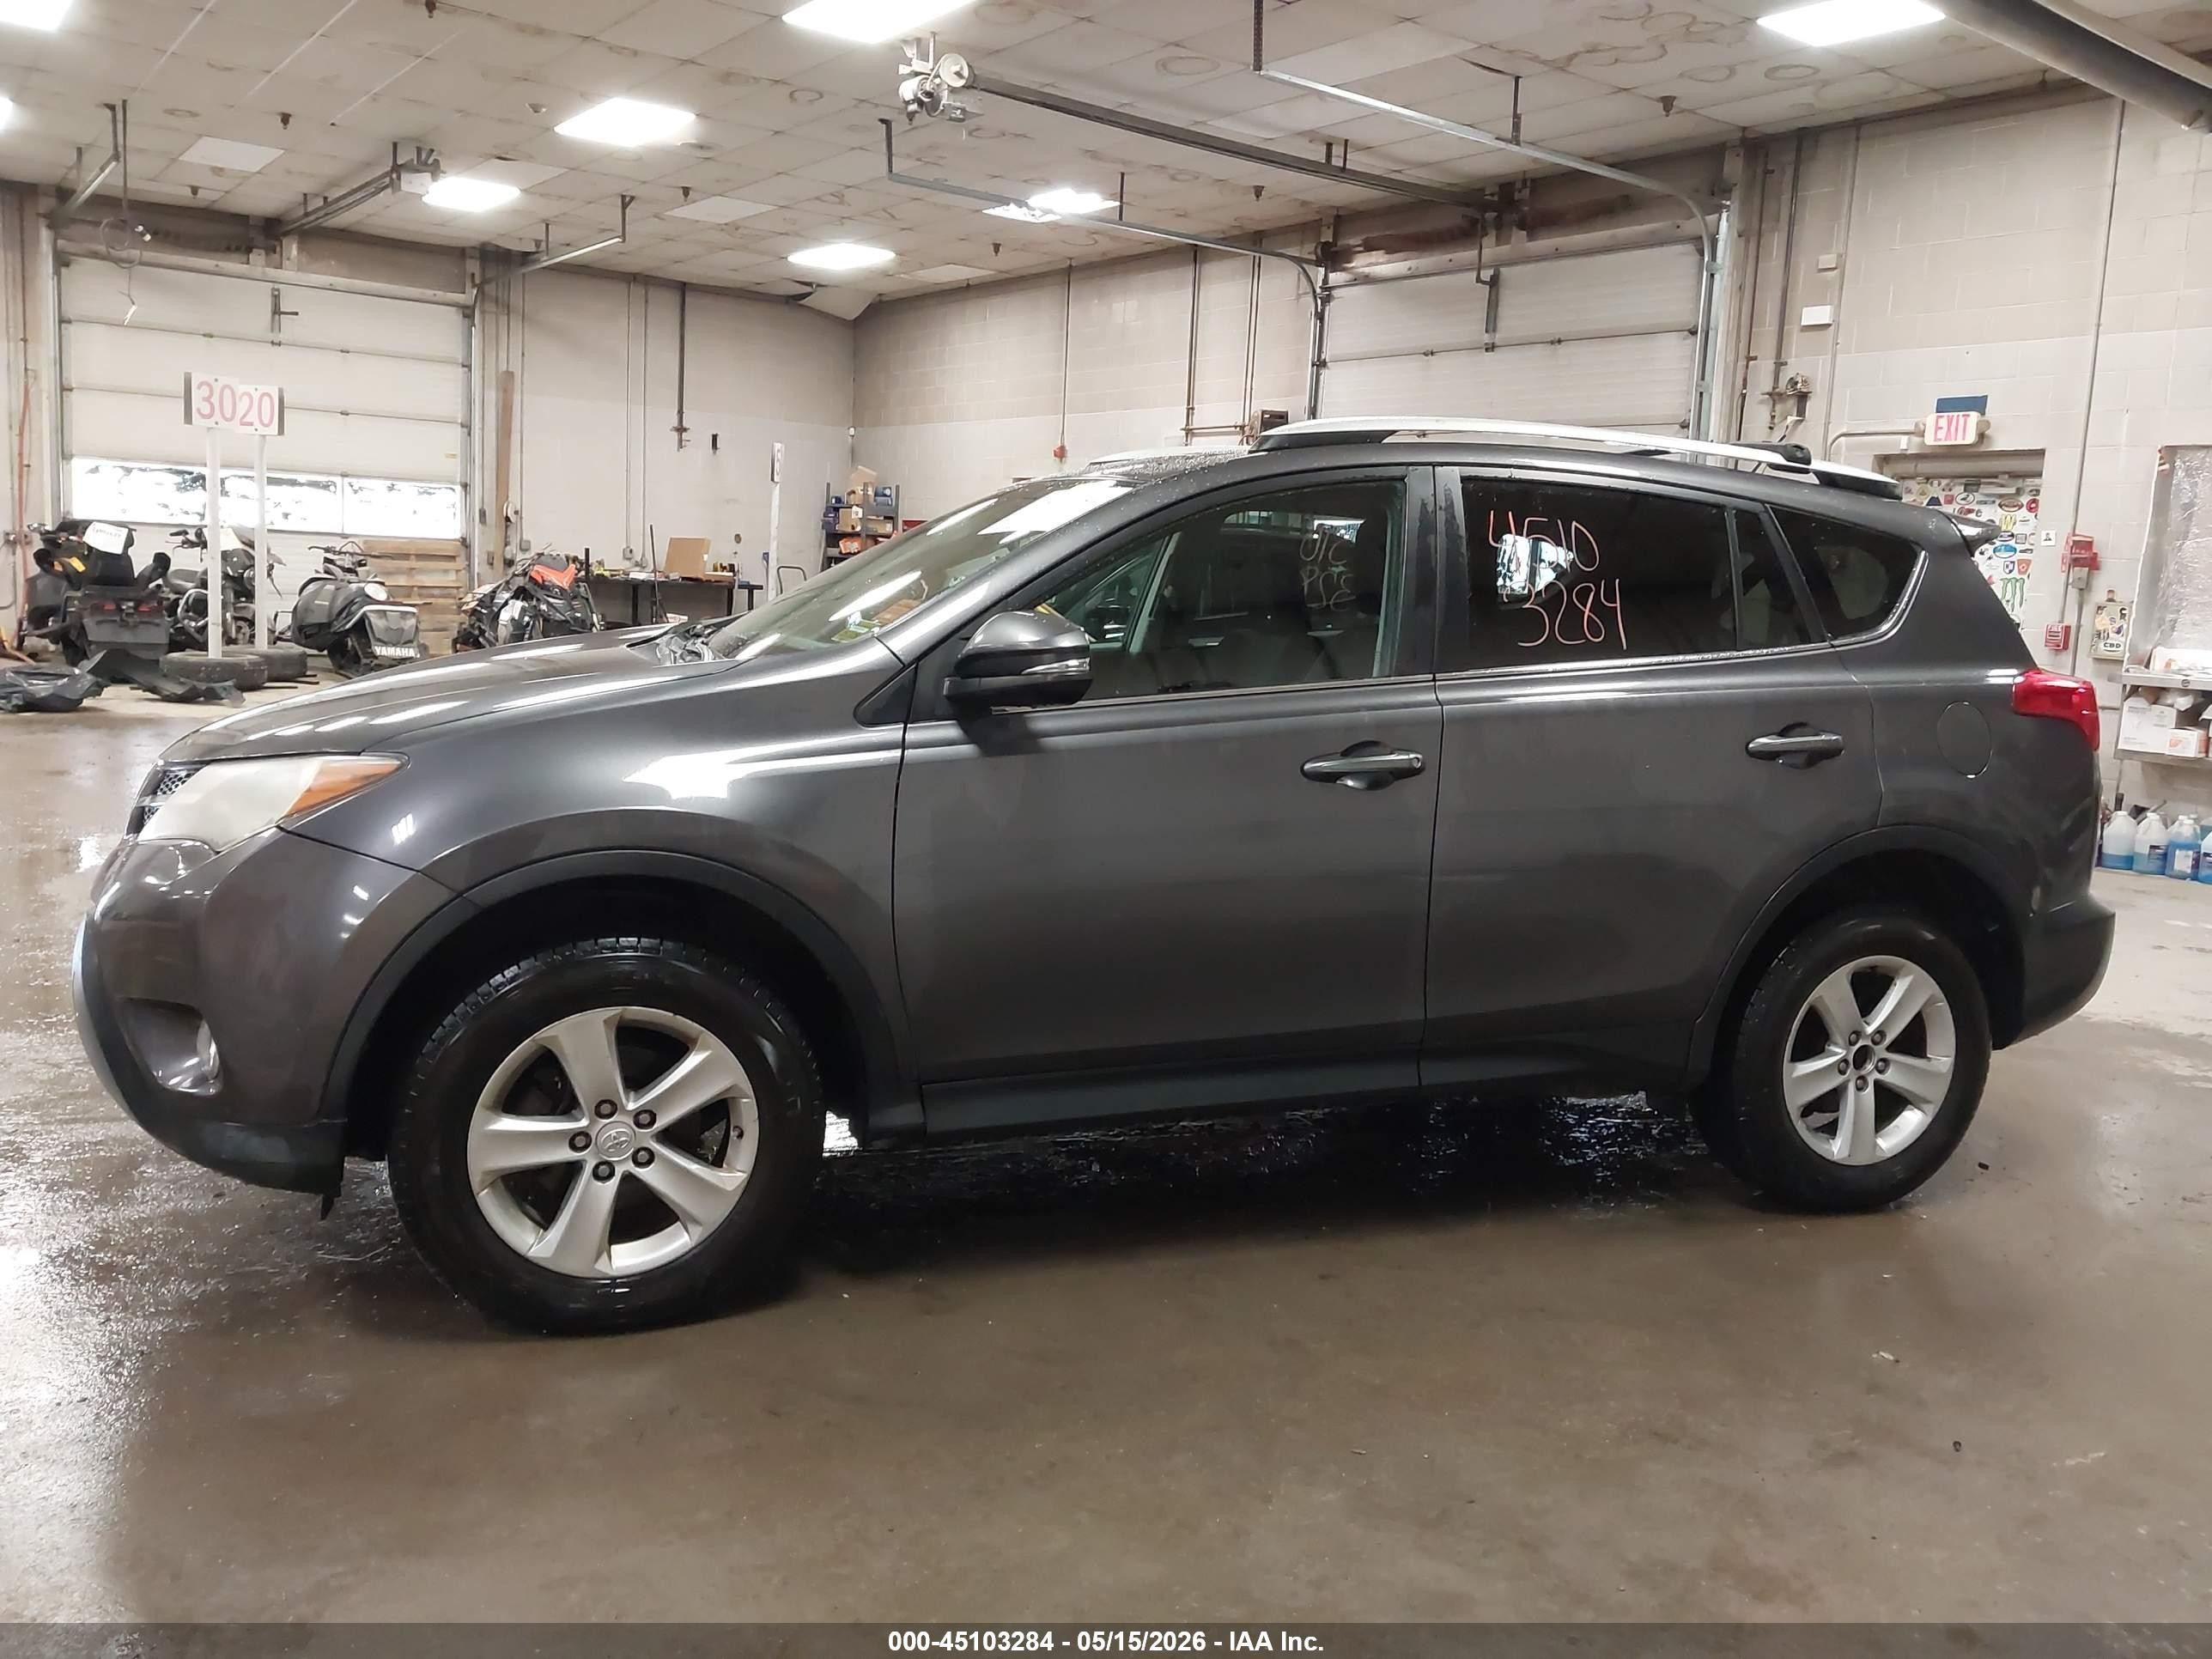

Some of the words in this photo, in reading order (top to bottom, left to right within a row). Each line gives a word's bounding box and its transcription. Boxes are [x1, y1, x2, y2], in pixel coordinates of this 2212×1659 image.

[1934, 414, 1971, 441] EXIT
[1488, 510, 1600, 572] 4510
[1504, 579, 1627, 650] 3284
[374, 646, 416, 658] YAMAHA
